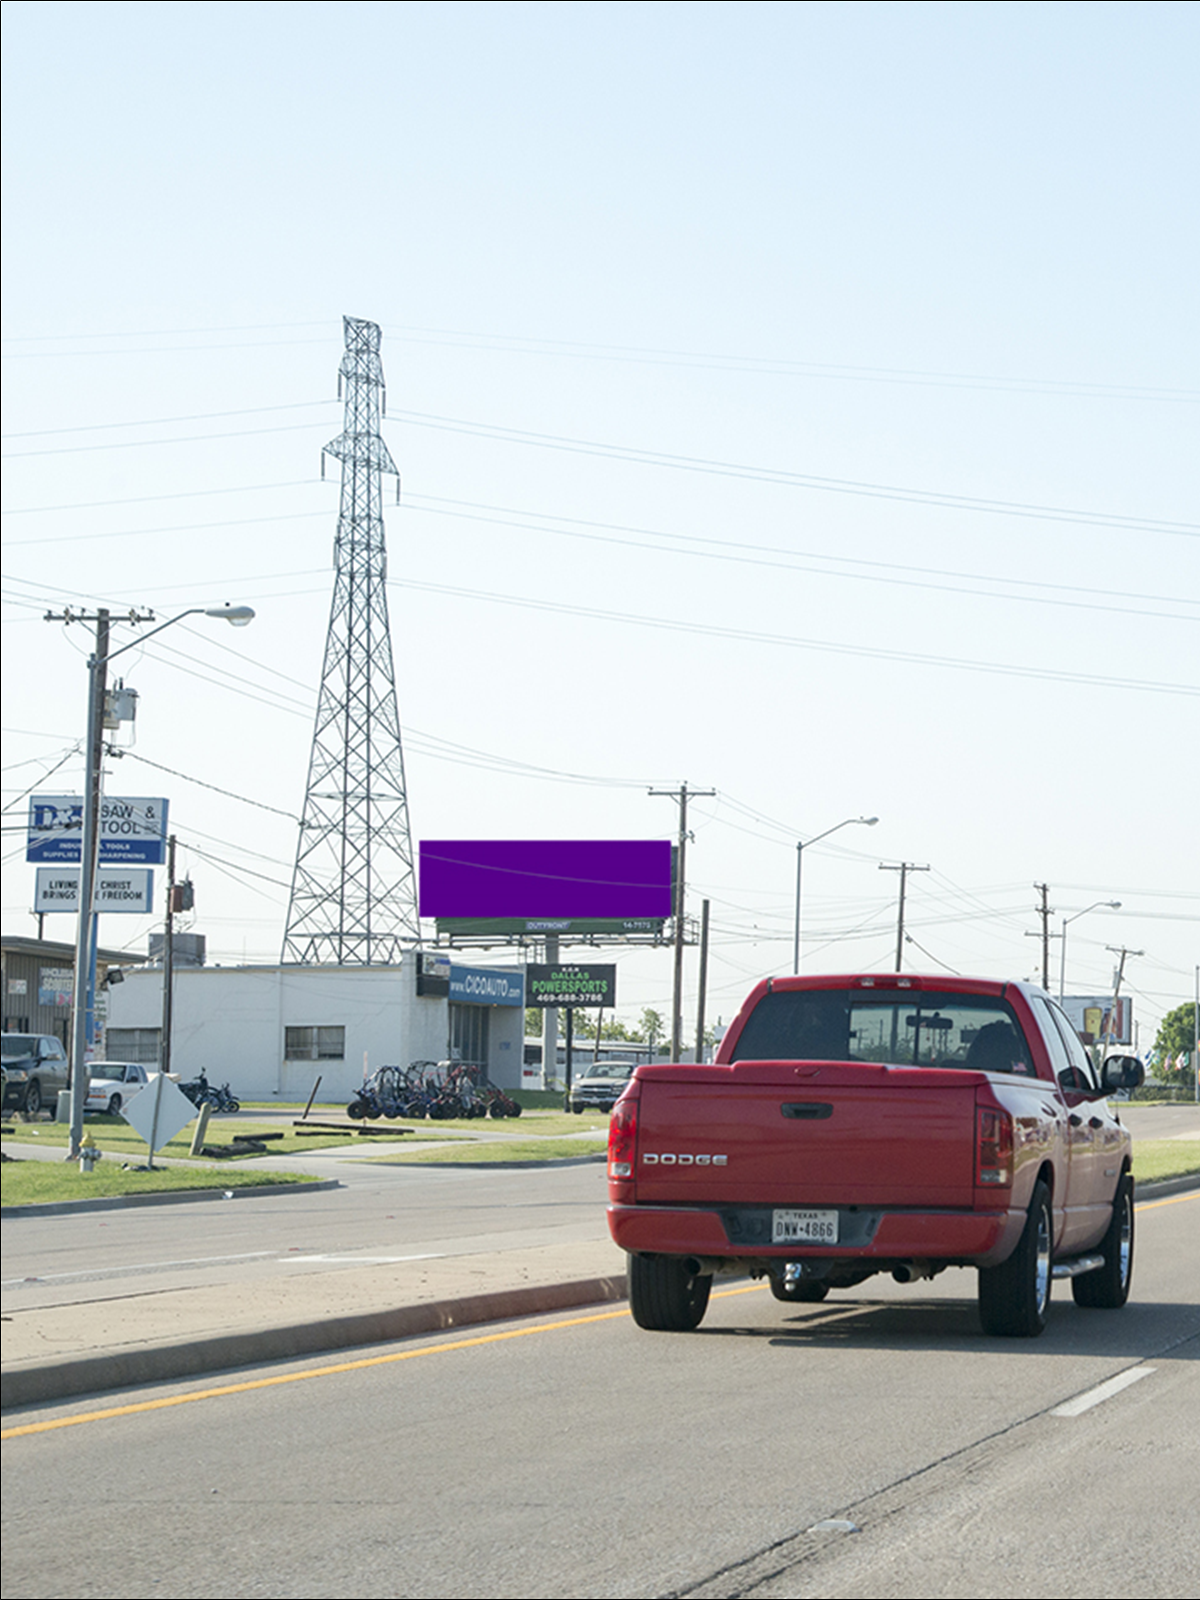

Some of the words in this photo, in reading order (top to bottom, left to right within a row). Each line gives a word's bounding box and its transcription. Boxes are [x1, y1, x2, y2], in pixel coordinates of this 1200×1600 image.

[101, 805, 134, 818] SAW
[145, 806, 155, 819] &
[101, 821, 141, 834] TOOL
[49, 880, 78, 889] LIVING
[101, 880, 132, 889] CHRIST
[42, 891, 76, 900] BRINGS
[102, 891, 143, 900] FREEDOM
[551, 972, 590, 980] DALLAS
[532, 981, 608, 993] POWERSPORTS
[642, 1153, 728, 1166] DODGE
